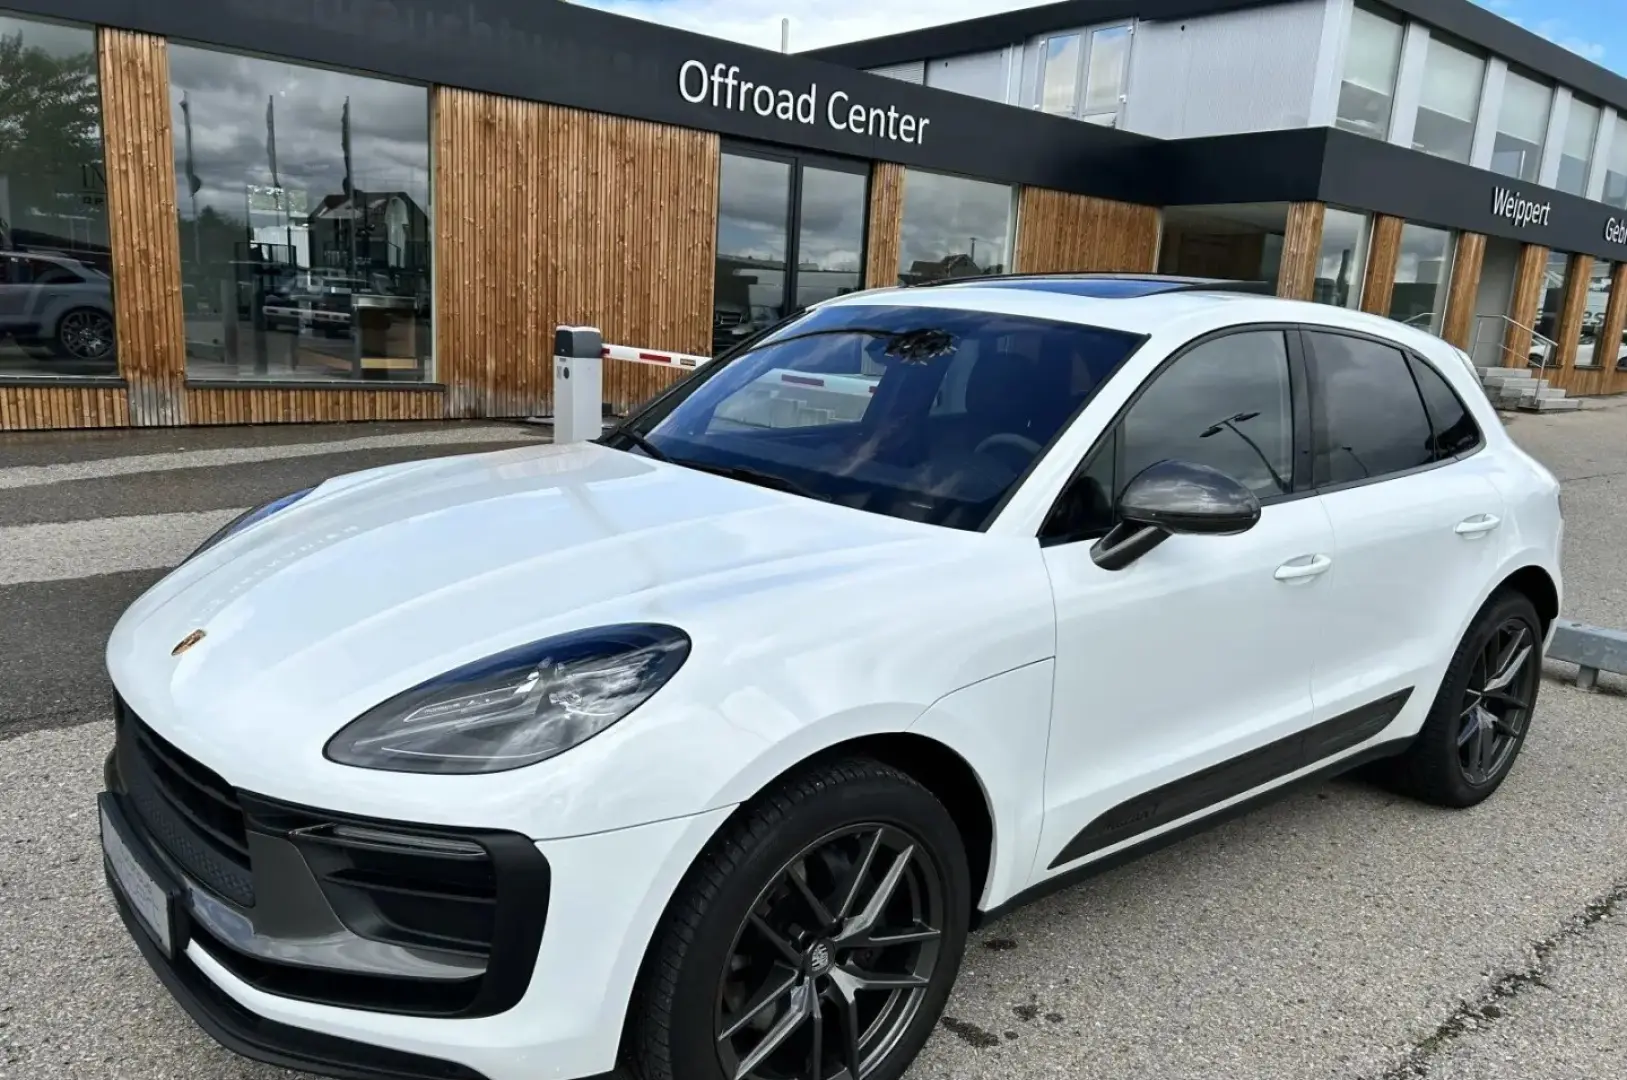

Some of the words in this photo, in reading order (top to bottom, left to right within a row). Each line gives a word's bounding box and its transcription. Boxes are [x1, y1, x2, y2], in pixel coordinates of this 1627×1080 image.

[679, 59, 817, 125] Offroad
[827, 91, 930, 145] Center
[1493, 186, 1551, 227] Weippert
